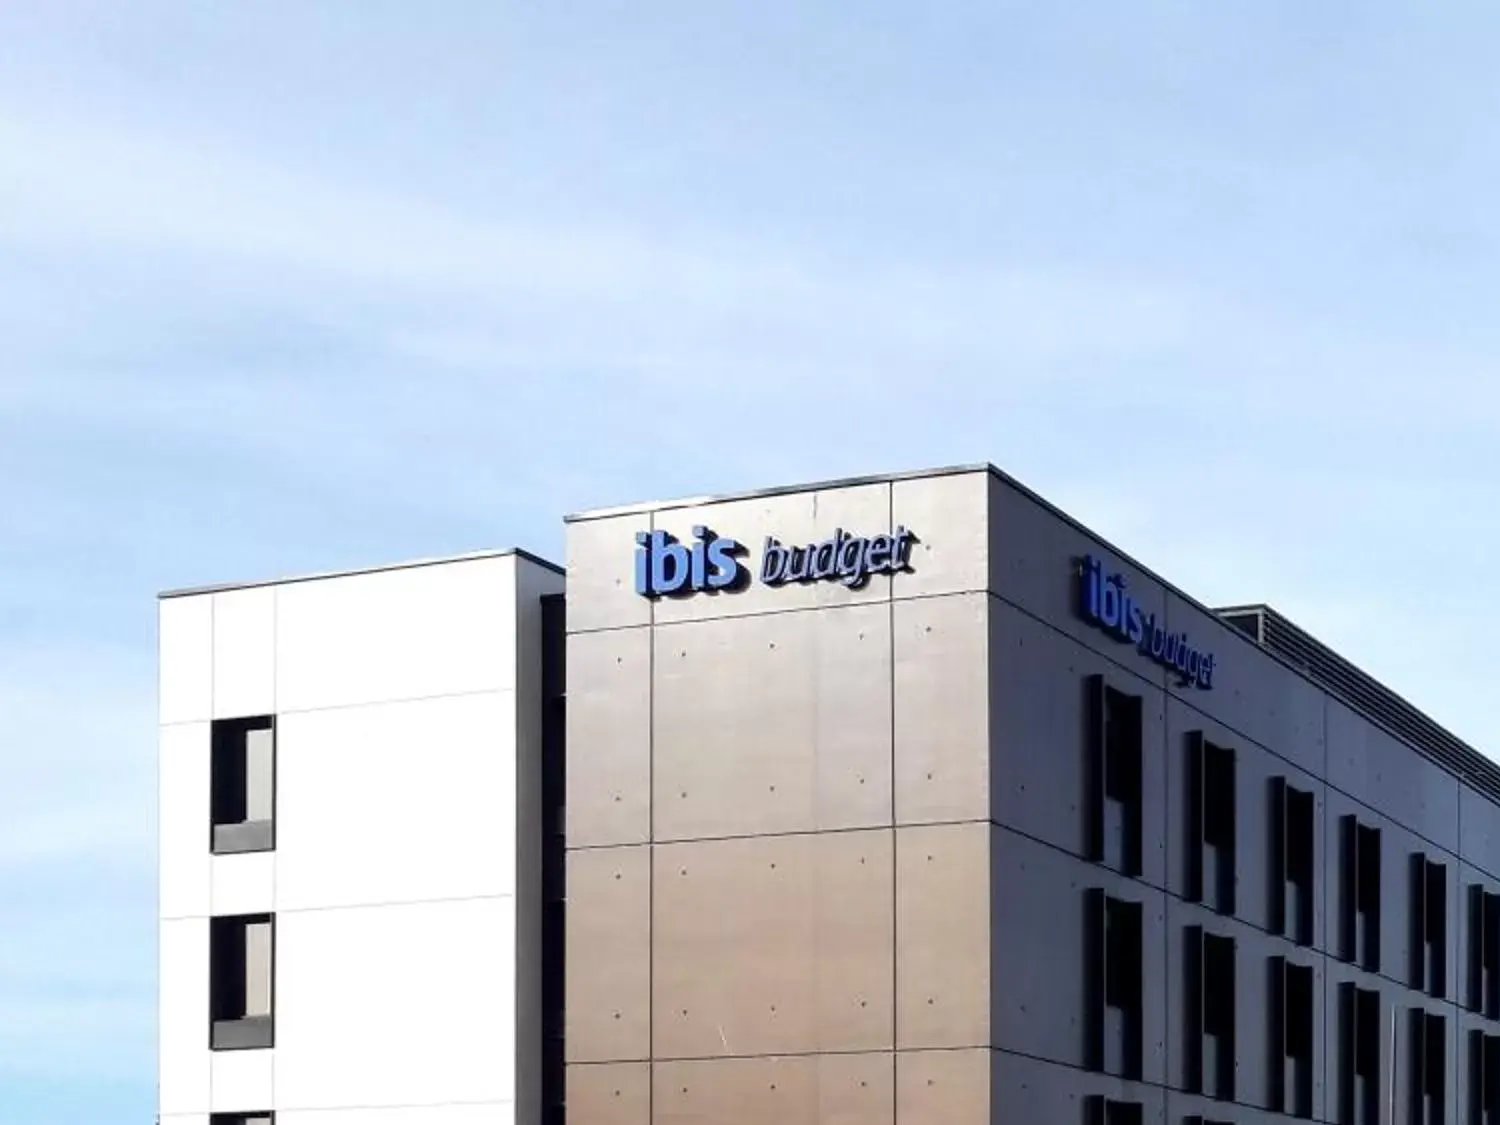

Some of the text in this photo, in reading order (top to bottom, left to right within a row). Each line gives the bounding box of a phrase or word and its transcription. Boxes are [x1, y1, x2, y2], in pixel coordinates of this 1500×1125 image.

[634, 525, 914, 595] ibis budget
[1084, 555, 1215, 689] ibis budget
